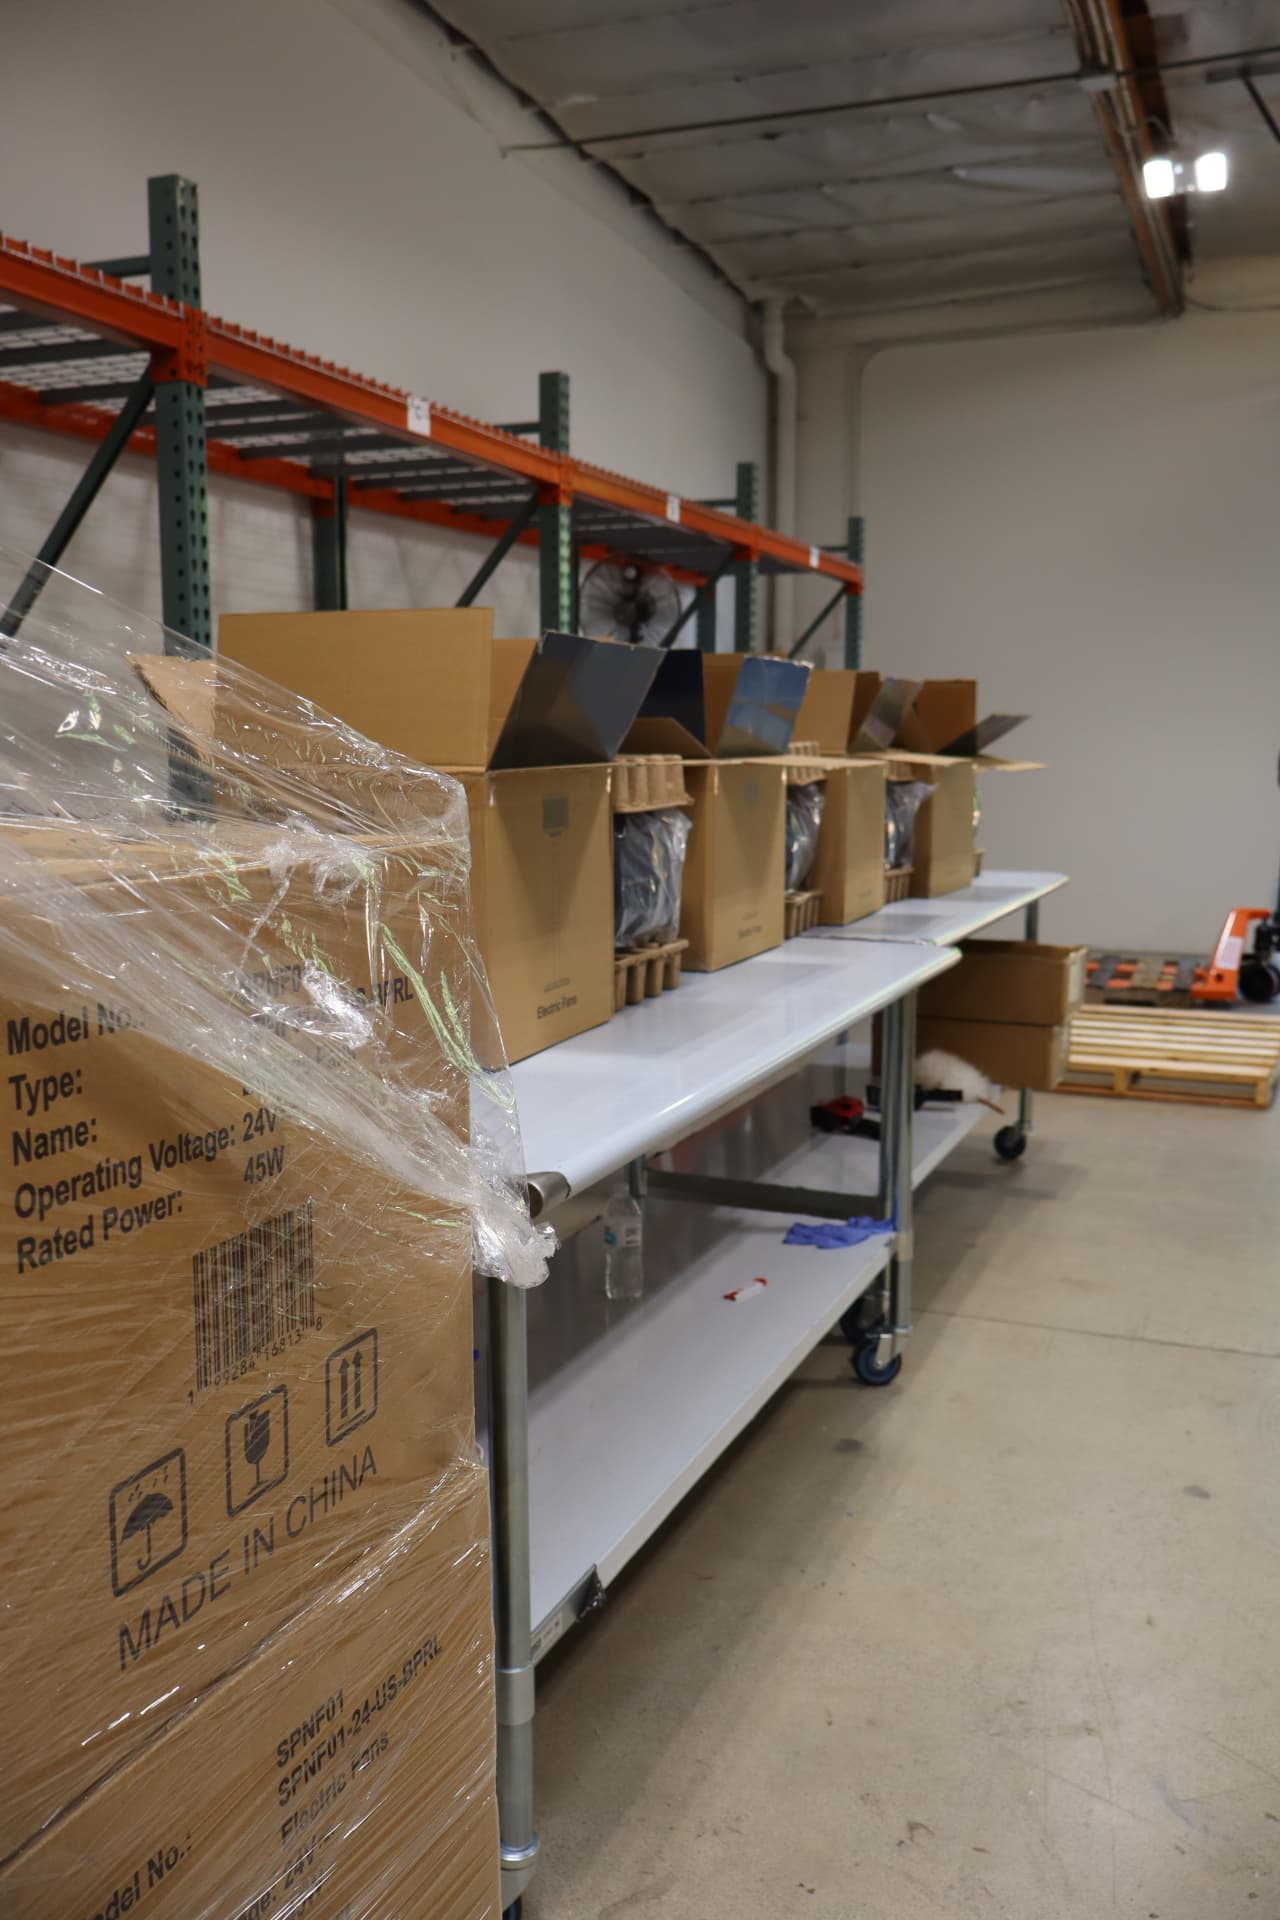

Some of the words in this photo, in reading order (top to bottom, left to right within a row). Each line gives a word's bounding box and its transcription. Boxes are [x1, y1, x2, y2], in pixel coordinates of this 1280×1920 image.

[7, 1006, 89, 1056] Model
[8, 1069, 82, 1116] Type:
[12, 1118, 97, 1167] Name:
[15, 1155, 142, 1222] Operating
[149, 1124, 236, 1172] Voltage:
[243, 1107, 276, 1142] 24V
[243, 1145, 285, 1184] 45W
[17, 1214, 94, 1274] Rated
[103, 1190, 183, 1240] Power:
[118, 1549, 232, 1671] MADE
[243, 1516, 275, 1576] IN
[285, 1445, 378, 1539] CHINA
[276, 1687, 344, 1769] SPNF01
